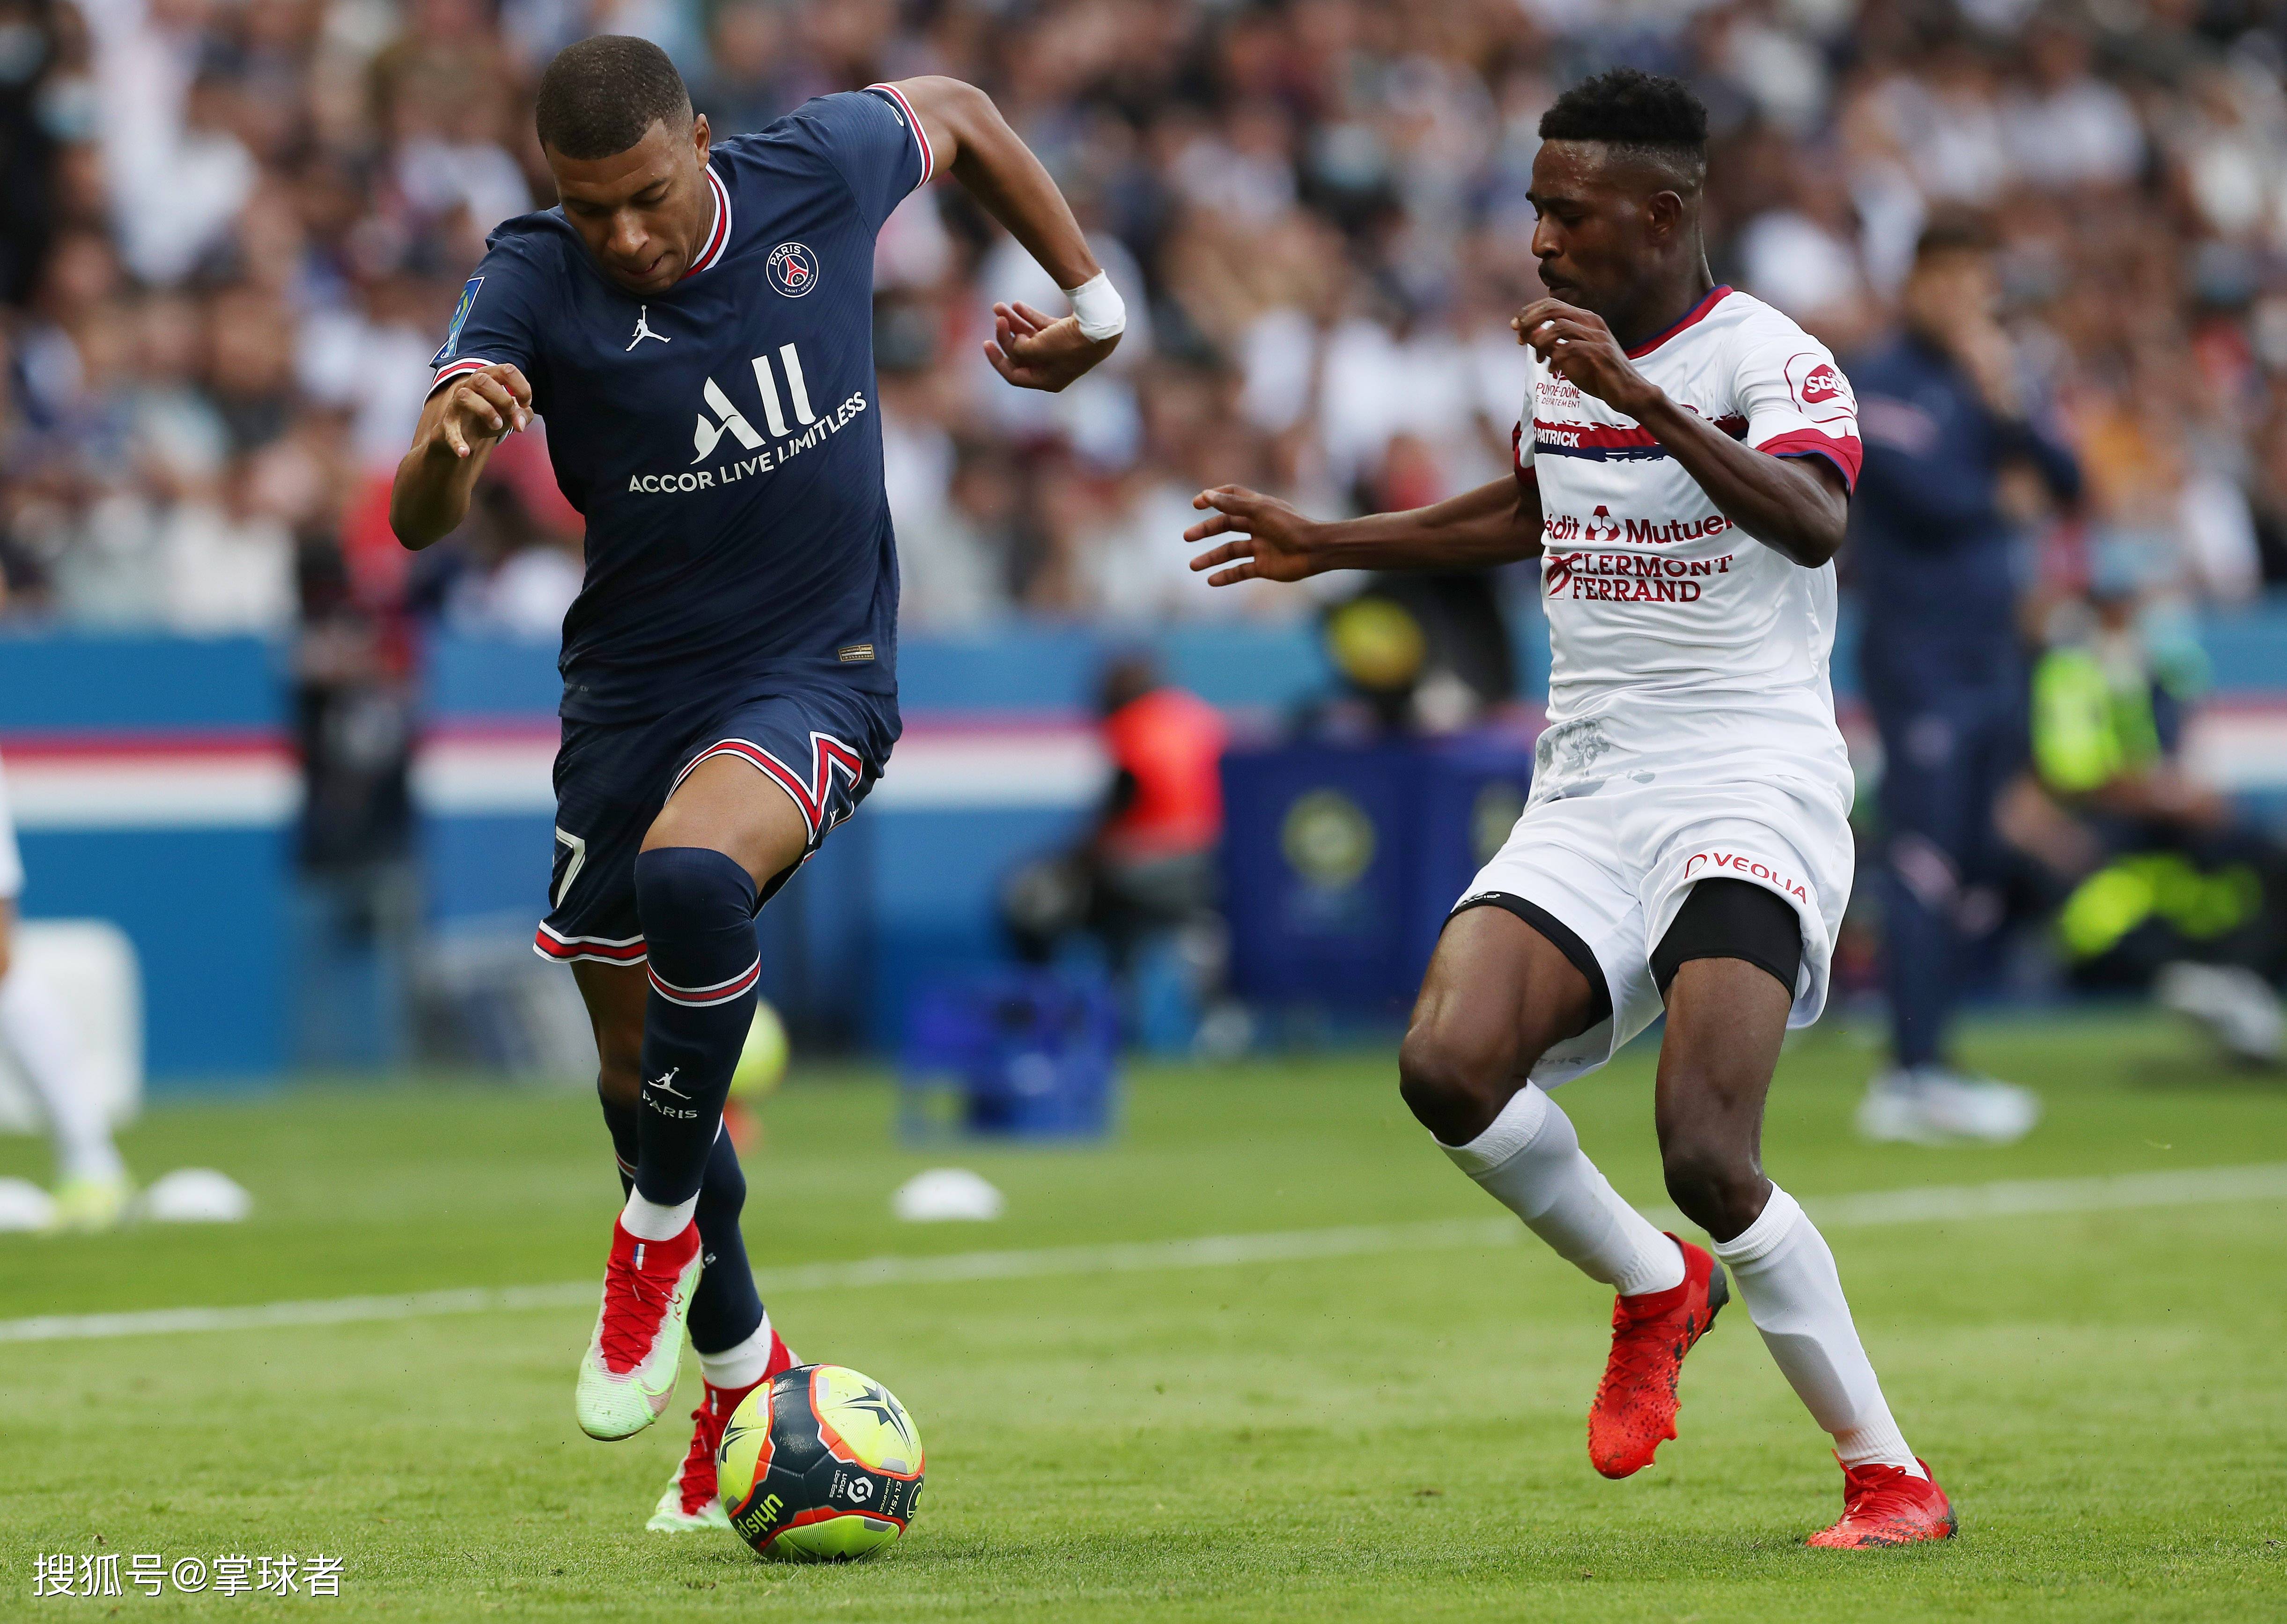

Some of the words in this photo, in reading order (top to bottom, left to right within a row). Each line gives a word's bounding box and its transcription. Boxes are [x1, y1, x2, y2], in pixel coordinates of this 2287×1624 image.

[770, 245, 801, 266] PARIS
[801, 273, 814, 291] GERMAIN
[629, 471, 716, 493] ACCOR
[720, 452, 775, 484] LIVE
[777, 391, 867, 464] LIMITLESS
[1537, 428, 1580, 448] PATRICK
[1569, 553, 1733, 577] CLERMONT
[1573, 576, 1701, 602] FERRAND
[556, 825, 585, 909] 7
[1713, 853, 1807, 905] VEOLIA
[642, 1089, 697, 1119] PARIS
[887, 1481, 902, 1516] ELYSIA
